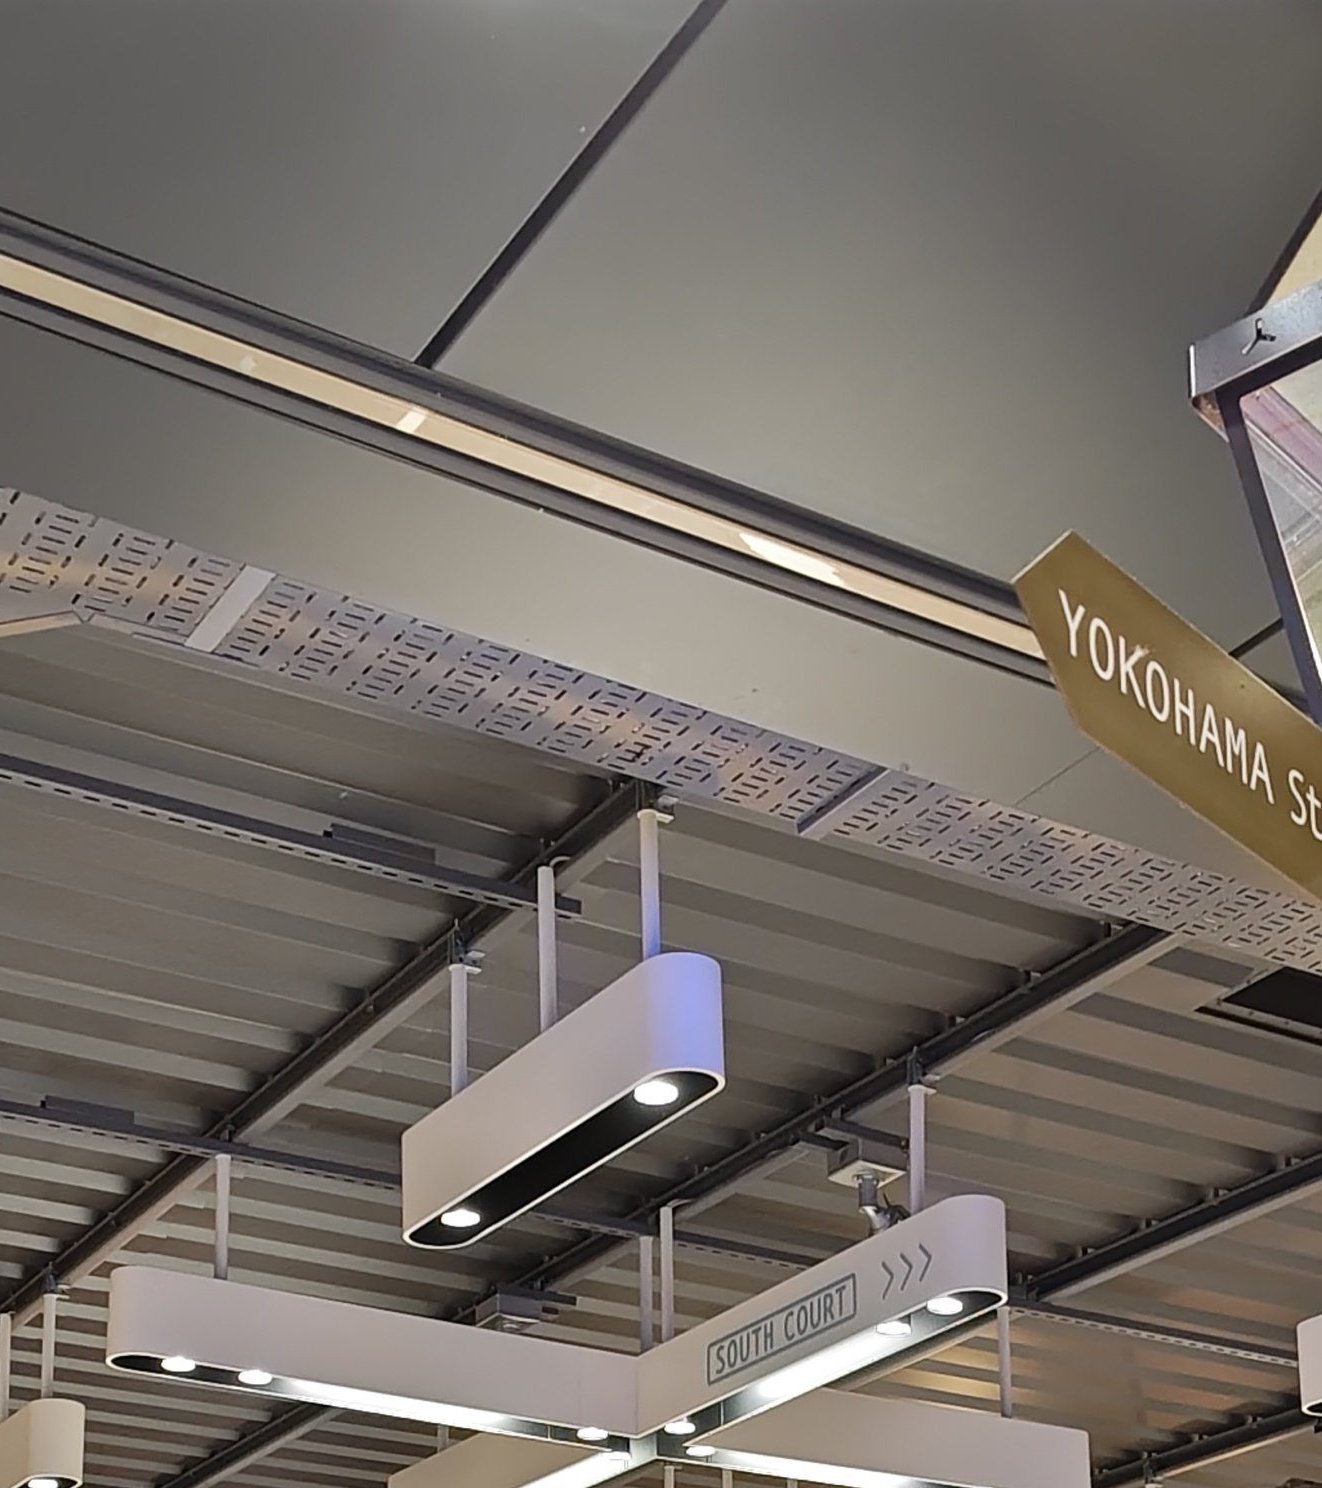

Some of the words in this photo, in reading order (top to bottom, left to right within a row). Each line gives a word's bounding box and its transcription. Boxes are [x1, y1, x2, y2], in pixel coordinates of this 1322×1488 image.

[1059, 588, 1275, 805] YOKOHAMA
[714, 1326, 774, 1375] SOUTH
[783, 1285, 848, 1341] COURT
